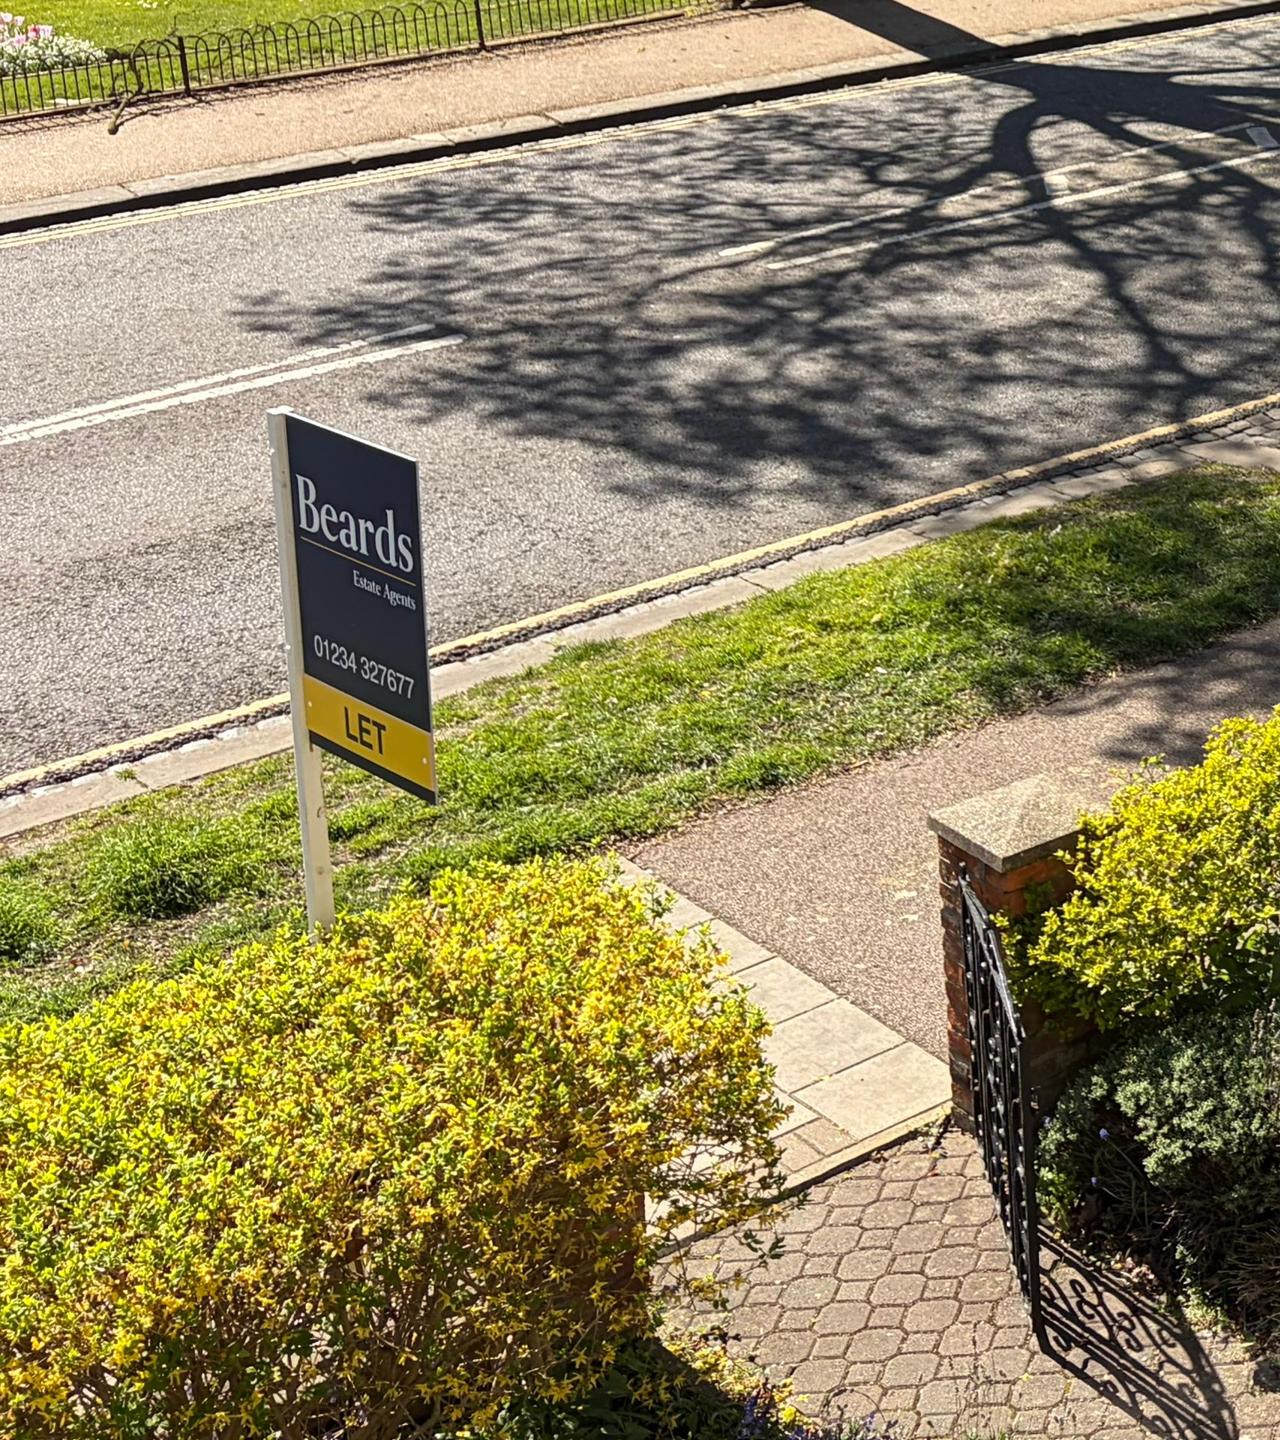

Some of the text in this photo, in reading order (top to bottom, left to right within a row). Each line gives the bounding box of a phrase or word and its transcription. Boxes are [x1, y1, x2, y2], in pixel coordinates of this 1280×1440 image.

[296, 473, 414, 573] Beards
[353, 570, 416, 610] Estate Agents
[313, 635, 414, 699] 01234 327677
[344, 706, 387, 755] LET
